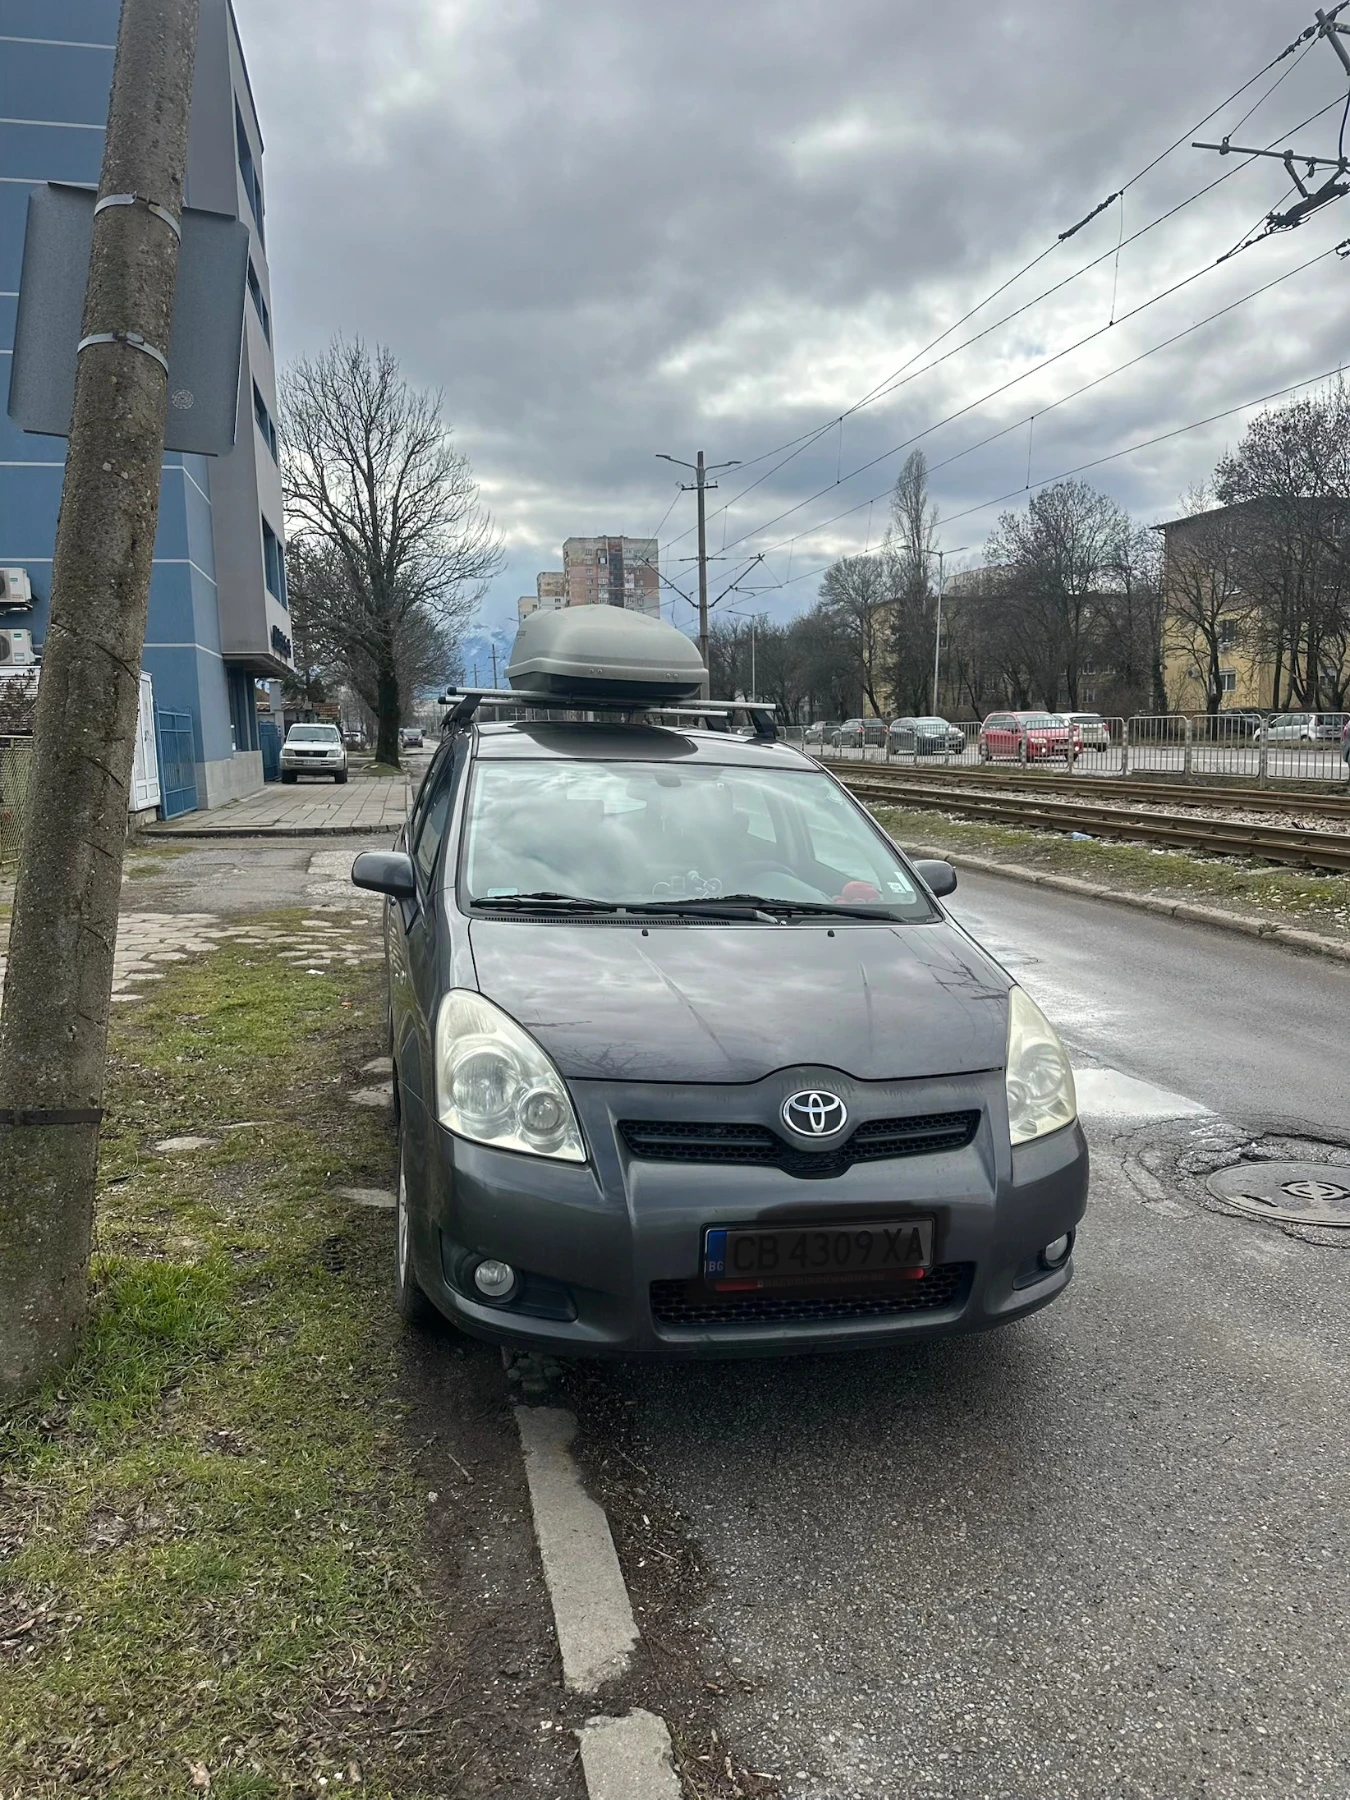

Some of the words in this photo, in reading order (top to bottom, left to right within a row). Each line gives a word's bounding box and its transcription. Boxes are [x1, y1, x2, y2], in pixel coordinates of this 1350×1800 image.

[733, 1235, 779, 1271] CB
[788, 1230, 874, 1269] 4309
[882, 1226, 924, 1264] XA
[708, 1260, 724, 1273] BG
